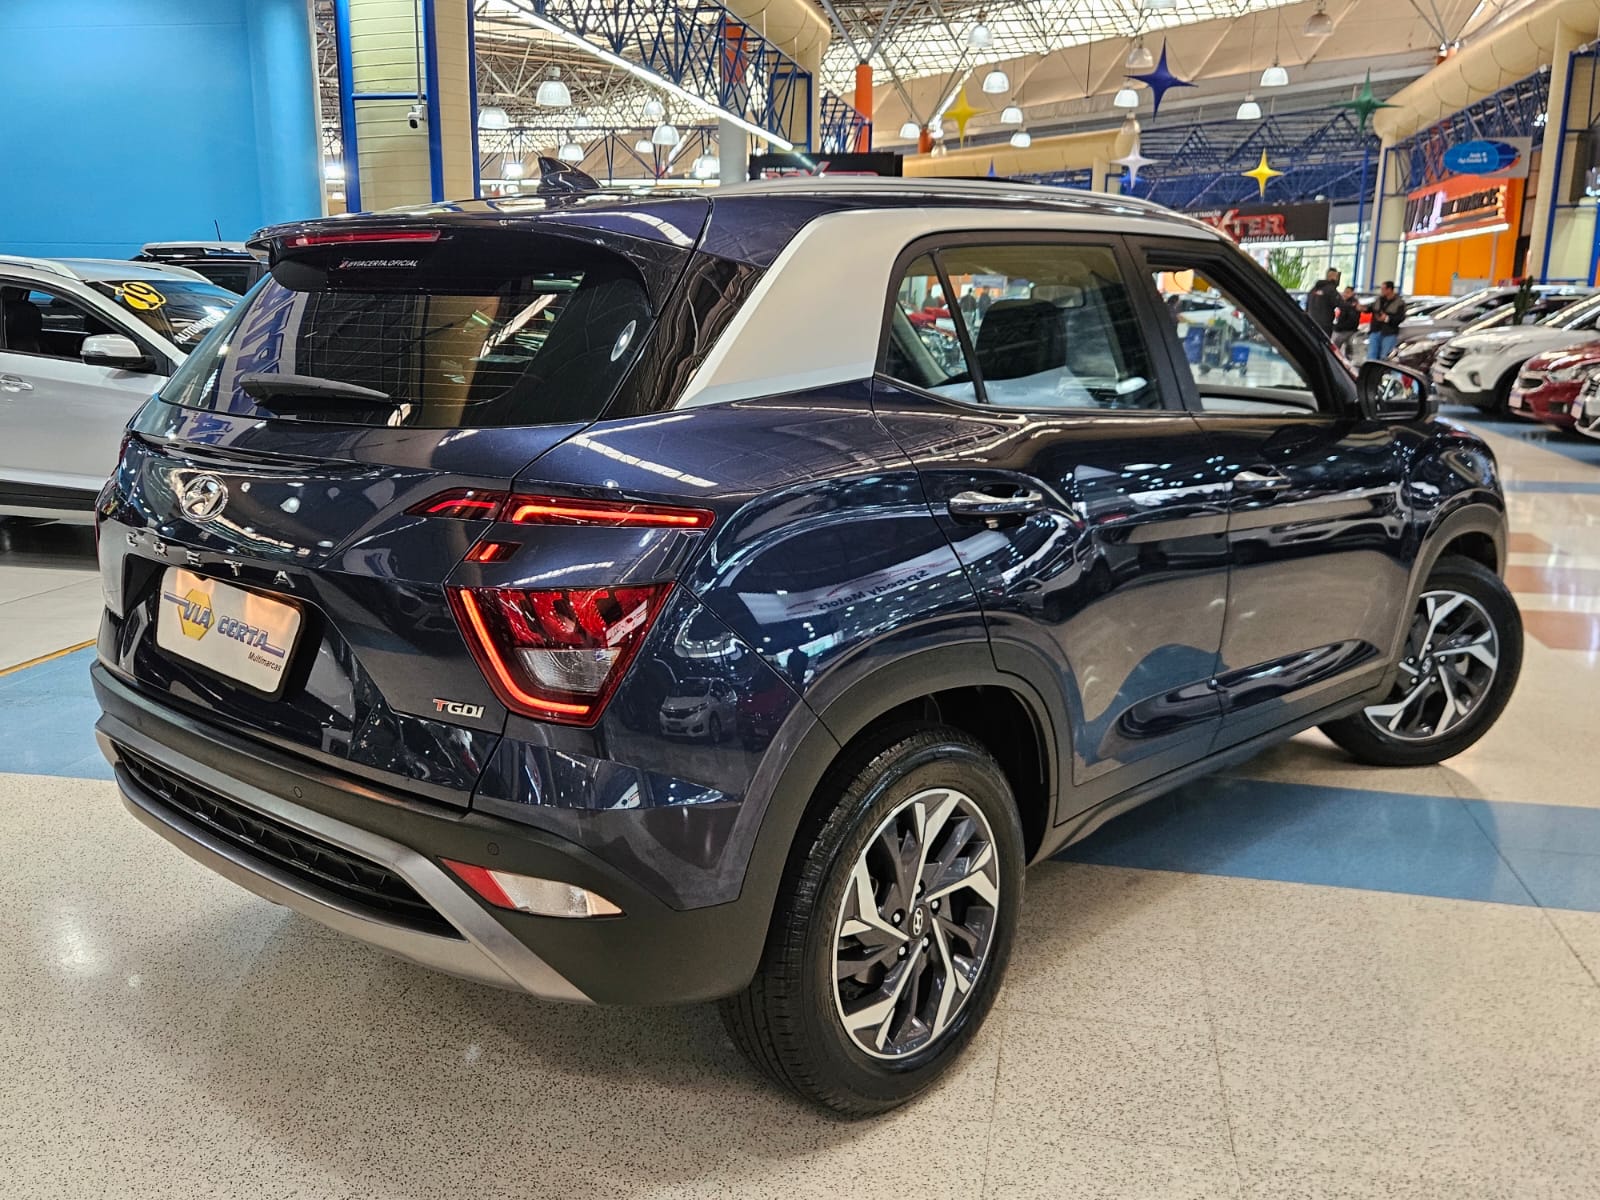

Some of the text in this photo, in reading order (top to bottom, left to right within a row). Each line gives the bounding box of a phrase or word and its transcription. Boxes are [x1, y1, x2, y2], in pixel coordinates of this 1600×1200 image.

[1240, 234, 1295, 242] MULTIMARCAS
[126, 531, 296, 589] CRETA
[182, 601, 269, 648] VIA CERTA
[248, 650, 282, 673] Multimarcas
[432, 698, 485, 719] TGDI
